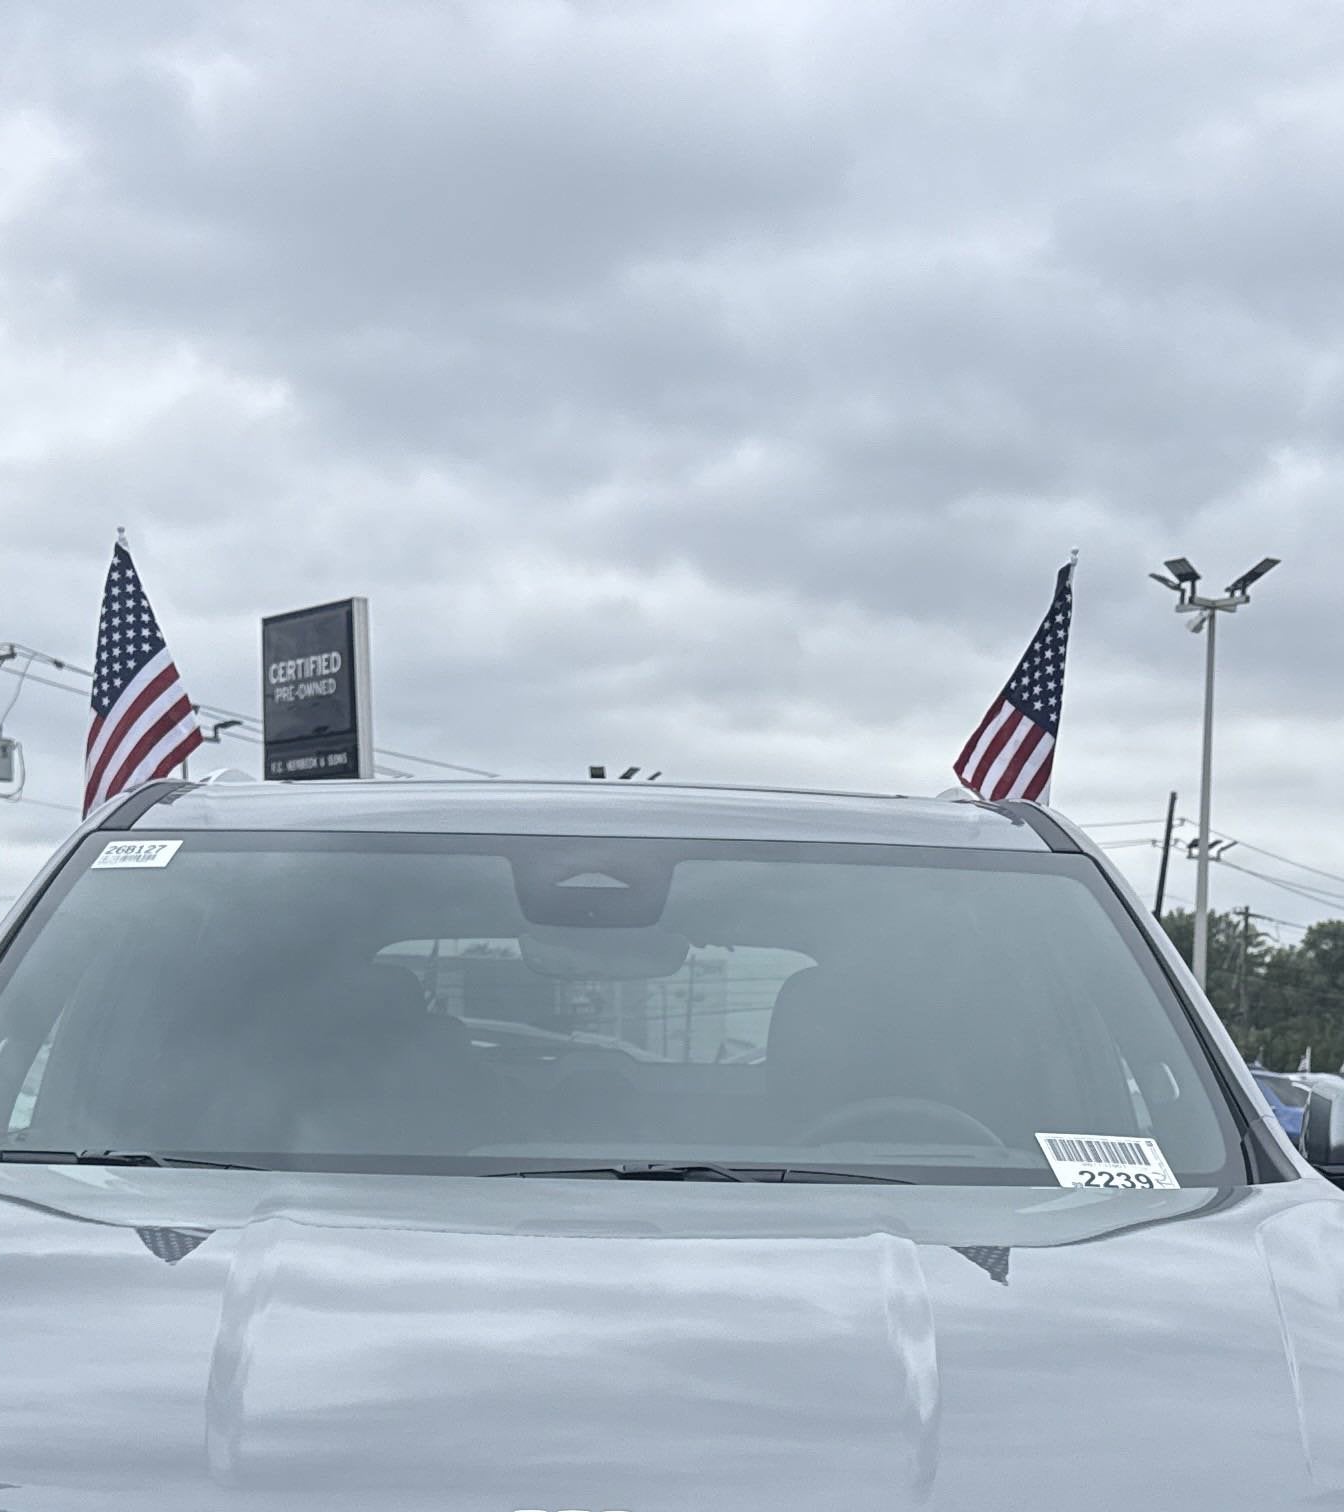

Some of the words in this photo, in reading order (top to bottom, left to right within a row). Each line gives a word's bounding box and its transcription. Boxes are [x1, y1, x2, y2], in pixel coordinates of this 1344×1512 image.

[269, 651, 342, 684] CERTIFIED
[274, 678, 336, 703] PRE-OWNED
[1078, 1171, 1154, 1189] 2239
